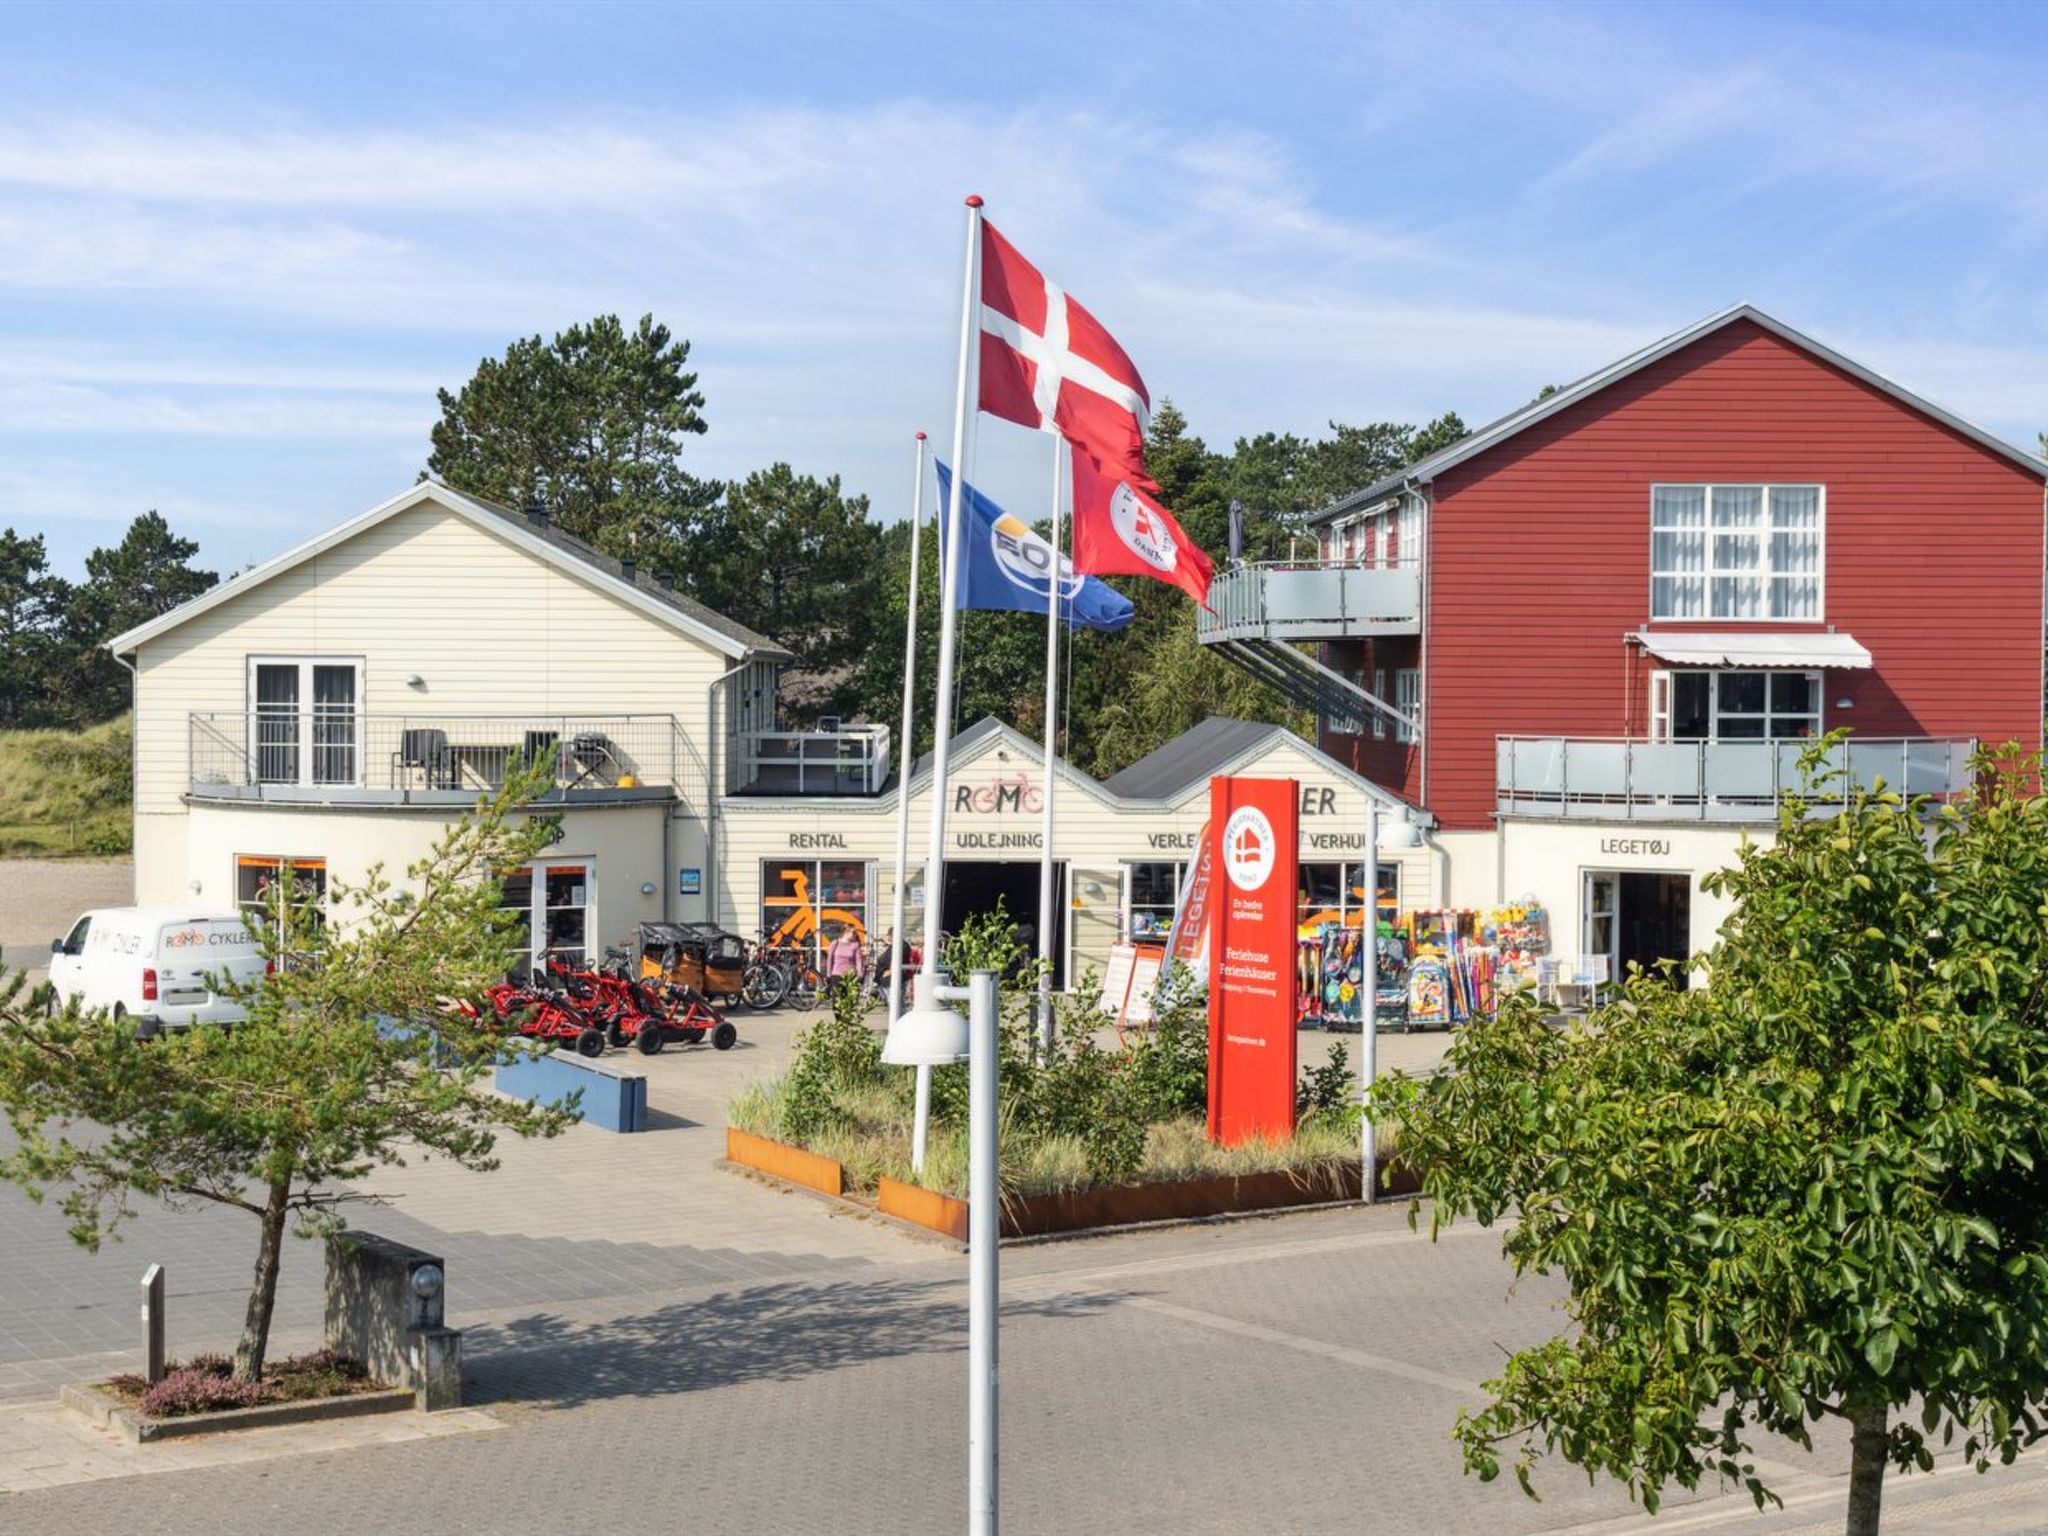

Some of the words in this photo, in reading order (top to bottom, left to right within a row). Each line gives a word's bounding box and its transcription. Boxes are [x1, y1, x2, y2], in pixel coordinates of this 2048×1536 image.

[1300, 787, 1336, 815] ER
[789, 833, 848, 848] RENTAL
[956, 833, 1044, 849] UDLEJNING
[1148, 833, 1196, 849] VERLE
[1601, 838, 1670, 856] LEGETØJ
[1226, 947, 1270, 964] Feriehuse
